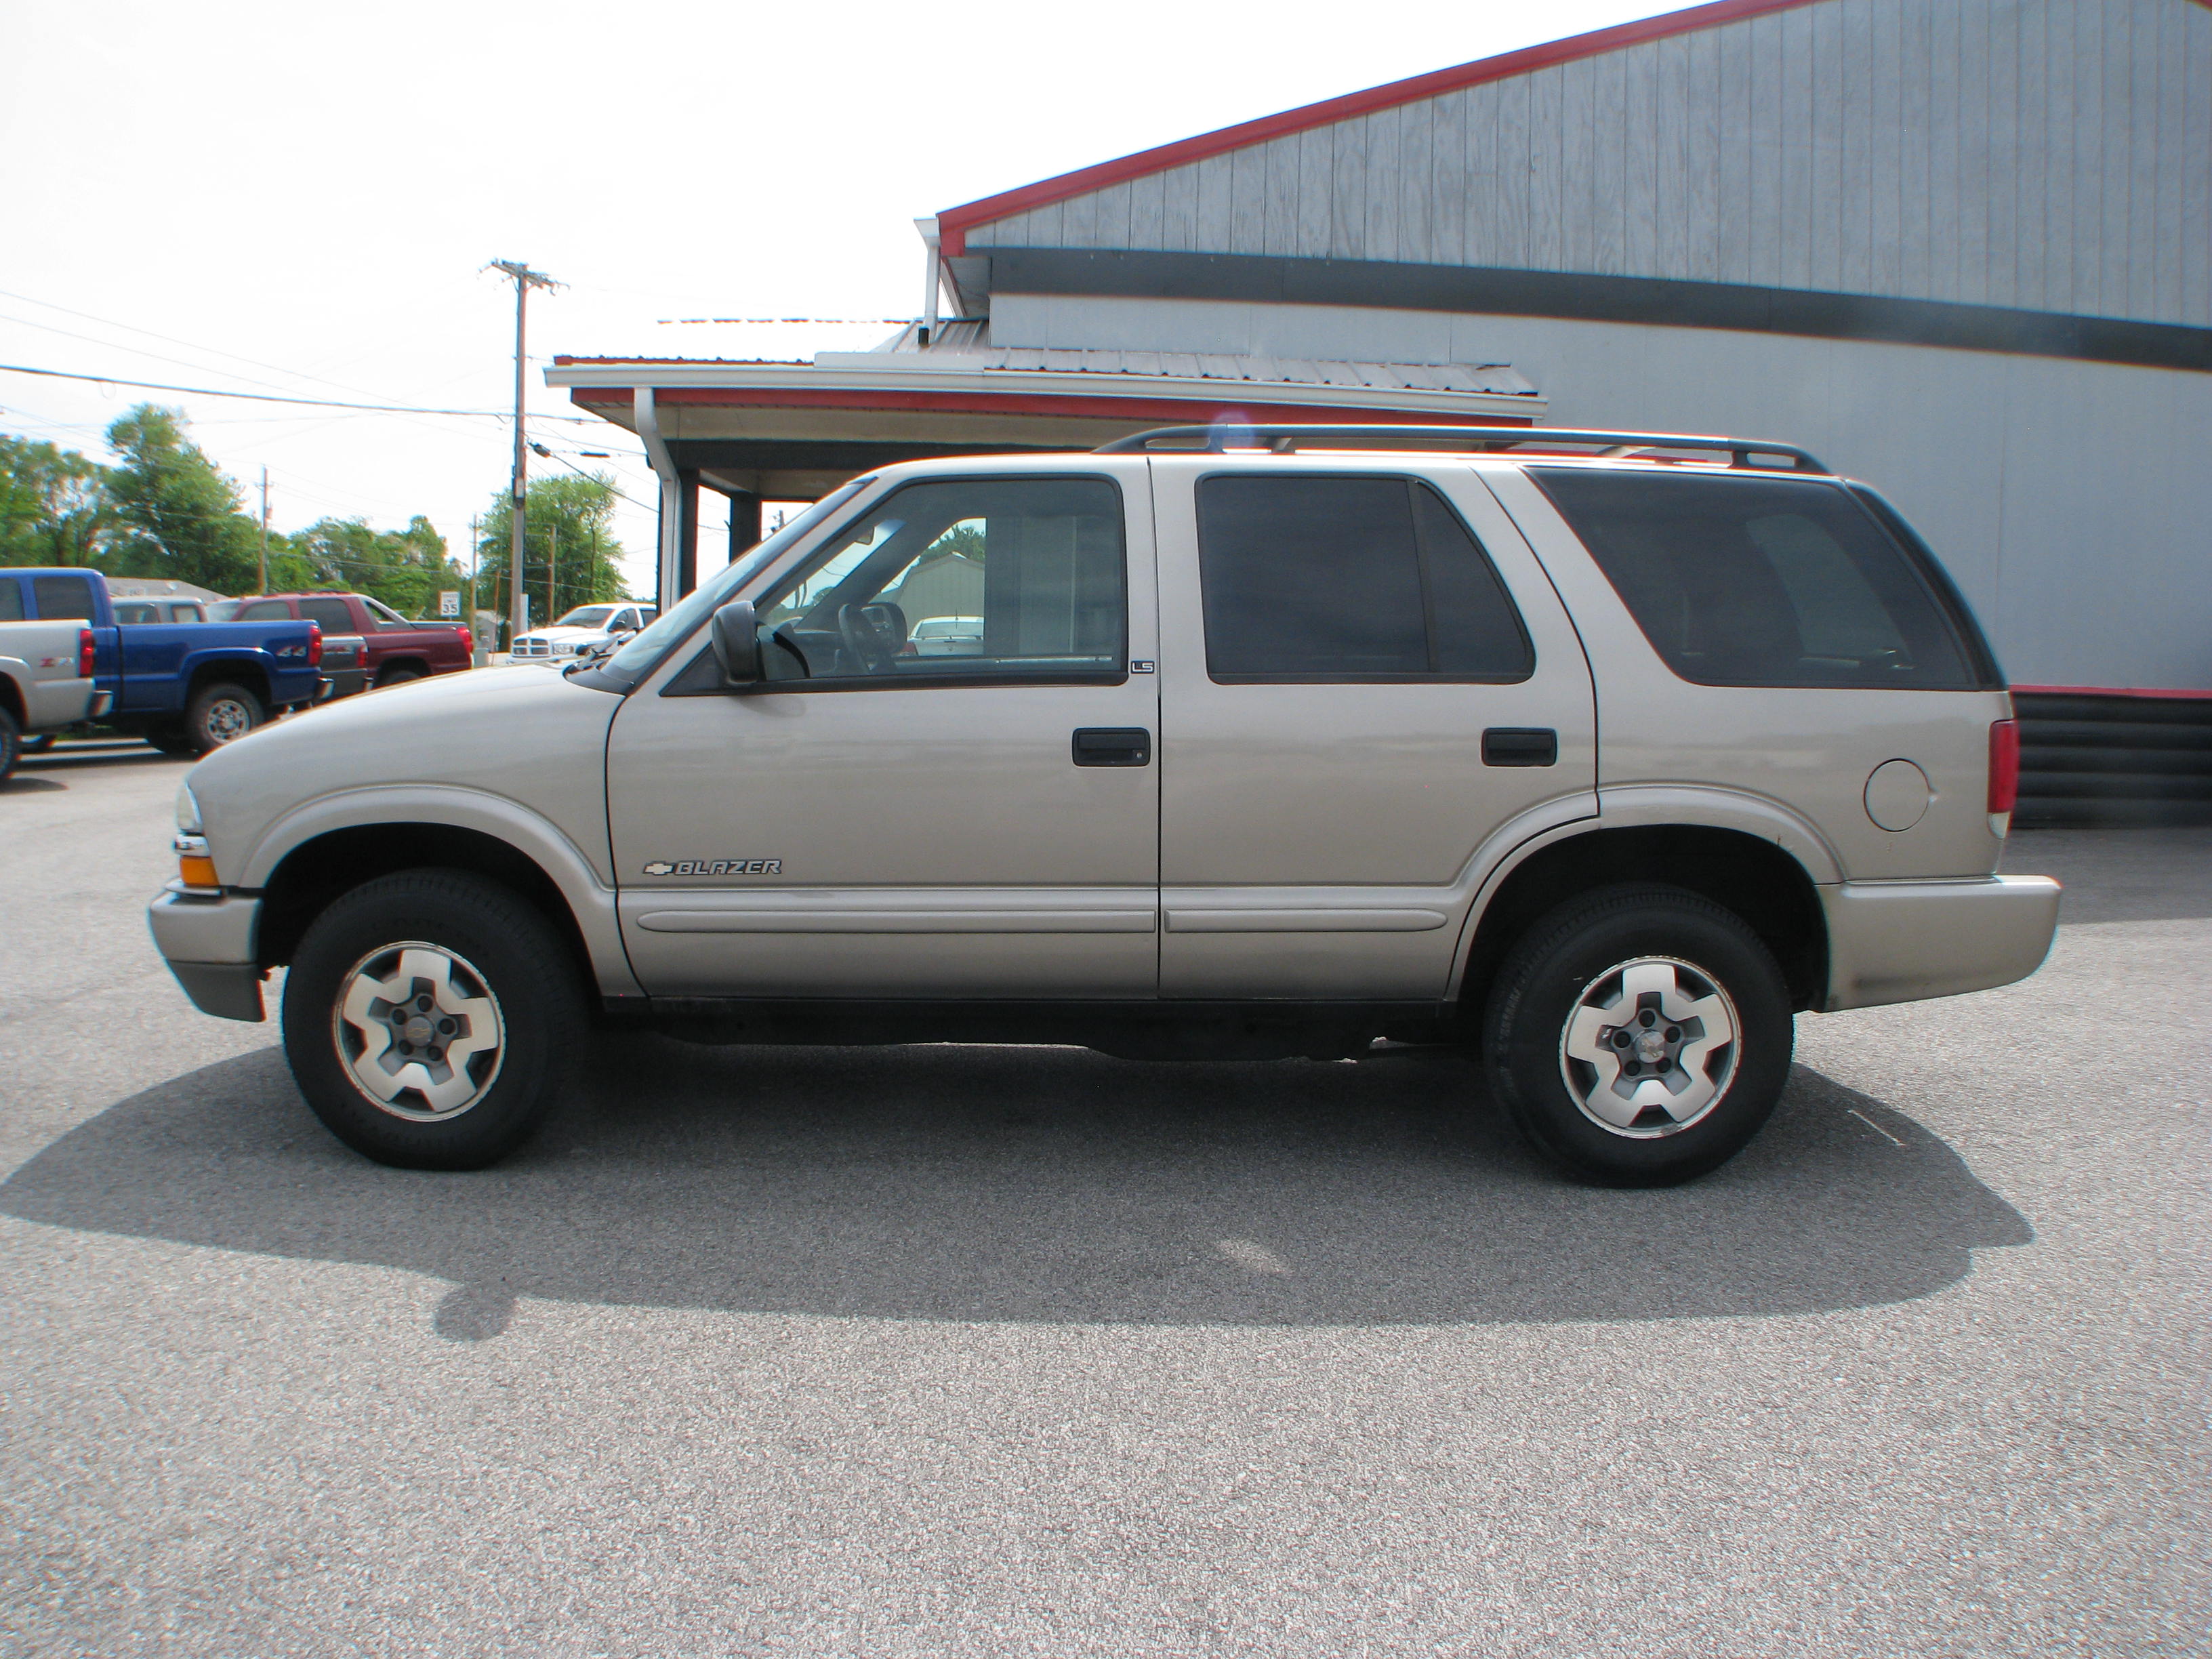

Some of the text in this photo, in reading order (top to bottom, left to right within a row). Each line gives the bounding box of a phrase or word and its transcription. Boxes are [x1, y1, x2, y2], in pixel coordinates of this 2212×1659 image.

[443, 604, 458, 613] 35
[276, 645, 307, 657] 44
[1132, 661, 1153, 672] LS
[676, 859, 781, 875] BLAZER
